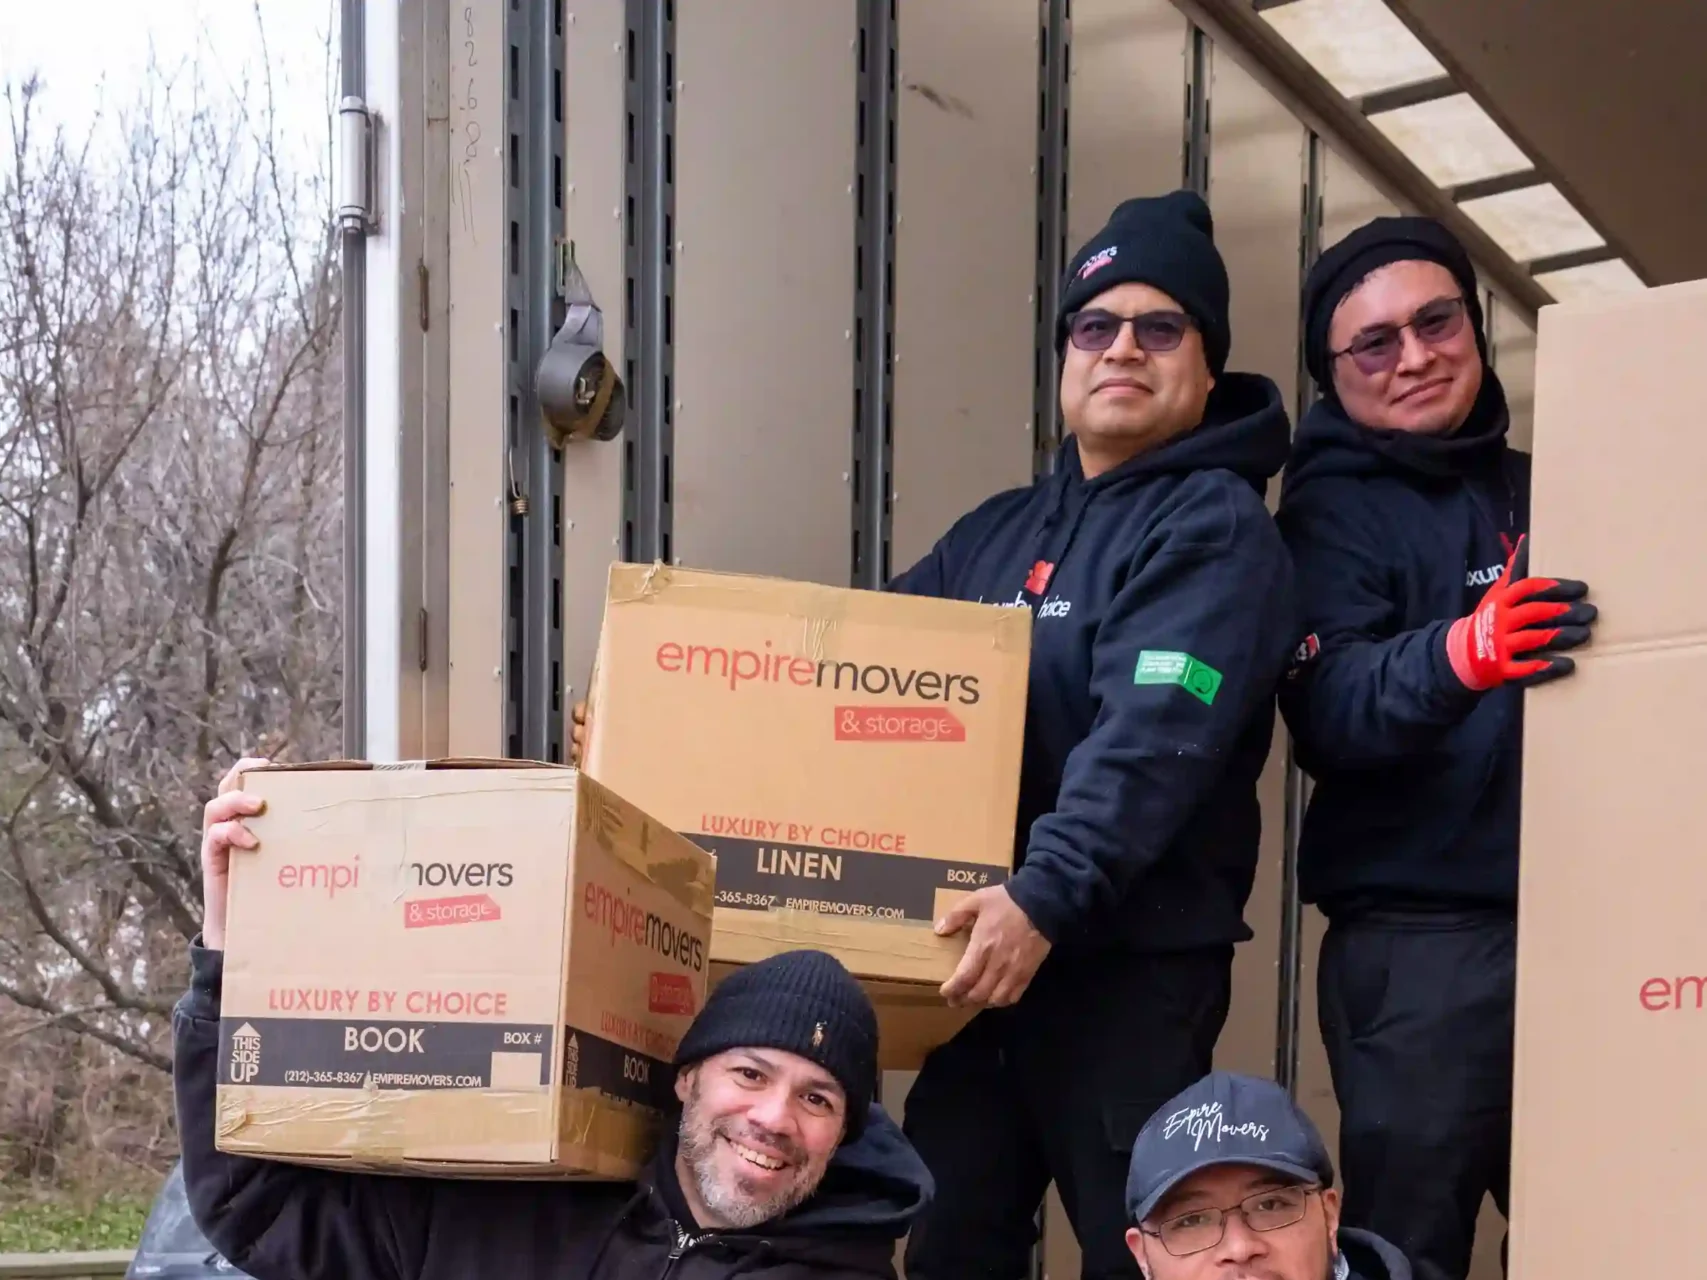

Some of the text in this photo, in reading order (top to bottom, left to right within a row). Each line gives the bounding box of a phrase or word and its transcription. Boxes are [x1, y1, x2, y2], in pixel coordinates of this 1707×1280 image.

[656, 640, 980, 705] empiremovers
[841, 709, 952, 740] & storage
[701, 813, 907, 853] LUXURY BY CHOICE
[277, 854, 514, 899] empiovers
[756, 848, 843, 881] LINEN
[947, 868, 989, 886] BOX #
[408, 902, 492, 922] & storage
[785, 897, 905, 920] EMPIREMOVERS.COM
[583, 880, 703, 973] empiremovers
[268, 988, 508, 1016] LUXURY BY CHOICE
[231, 1036, 261, 1051] THIS
[344, 1026, 425, 1053] BOOK
[503, 1031, 543, 1046] BOX #
[231, 1051, 261, 1065] SIDE
[623, 1054, 651, 1085] BOOK
[230, 1063, 260, 1084] UP
[284, 1069, 483, 1089] (212)-365-8367 EMPIREMOVERS.COM
[1191, 1112, 1270, 1152] Movers
